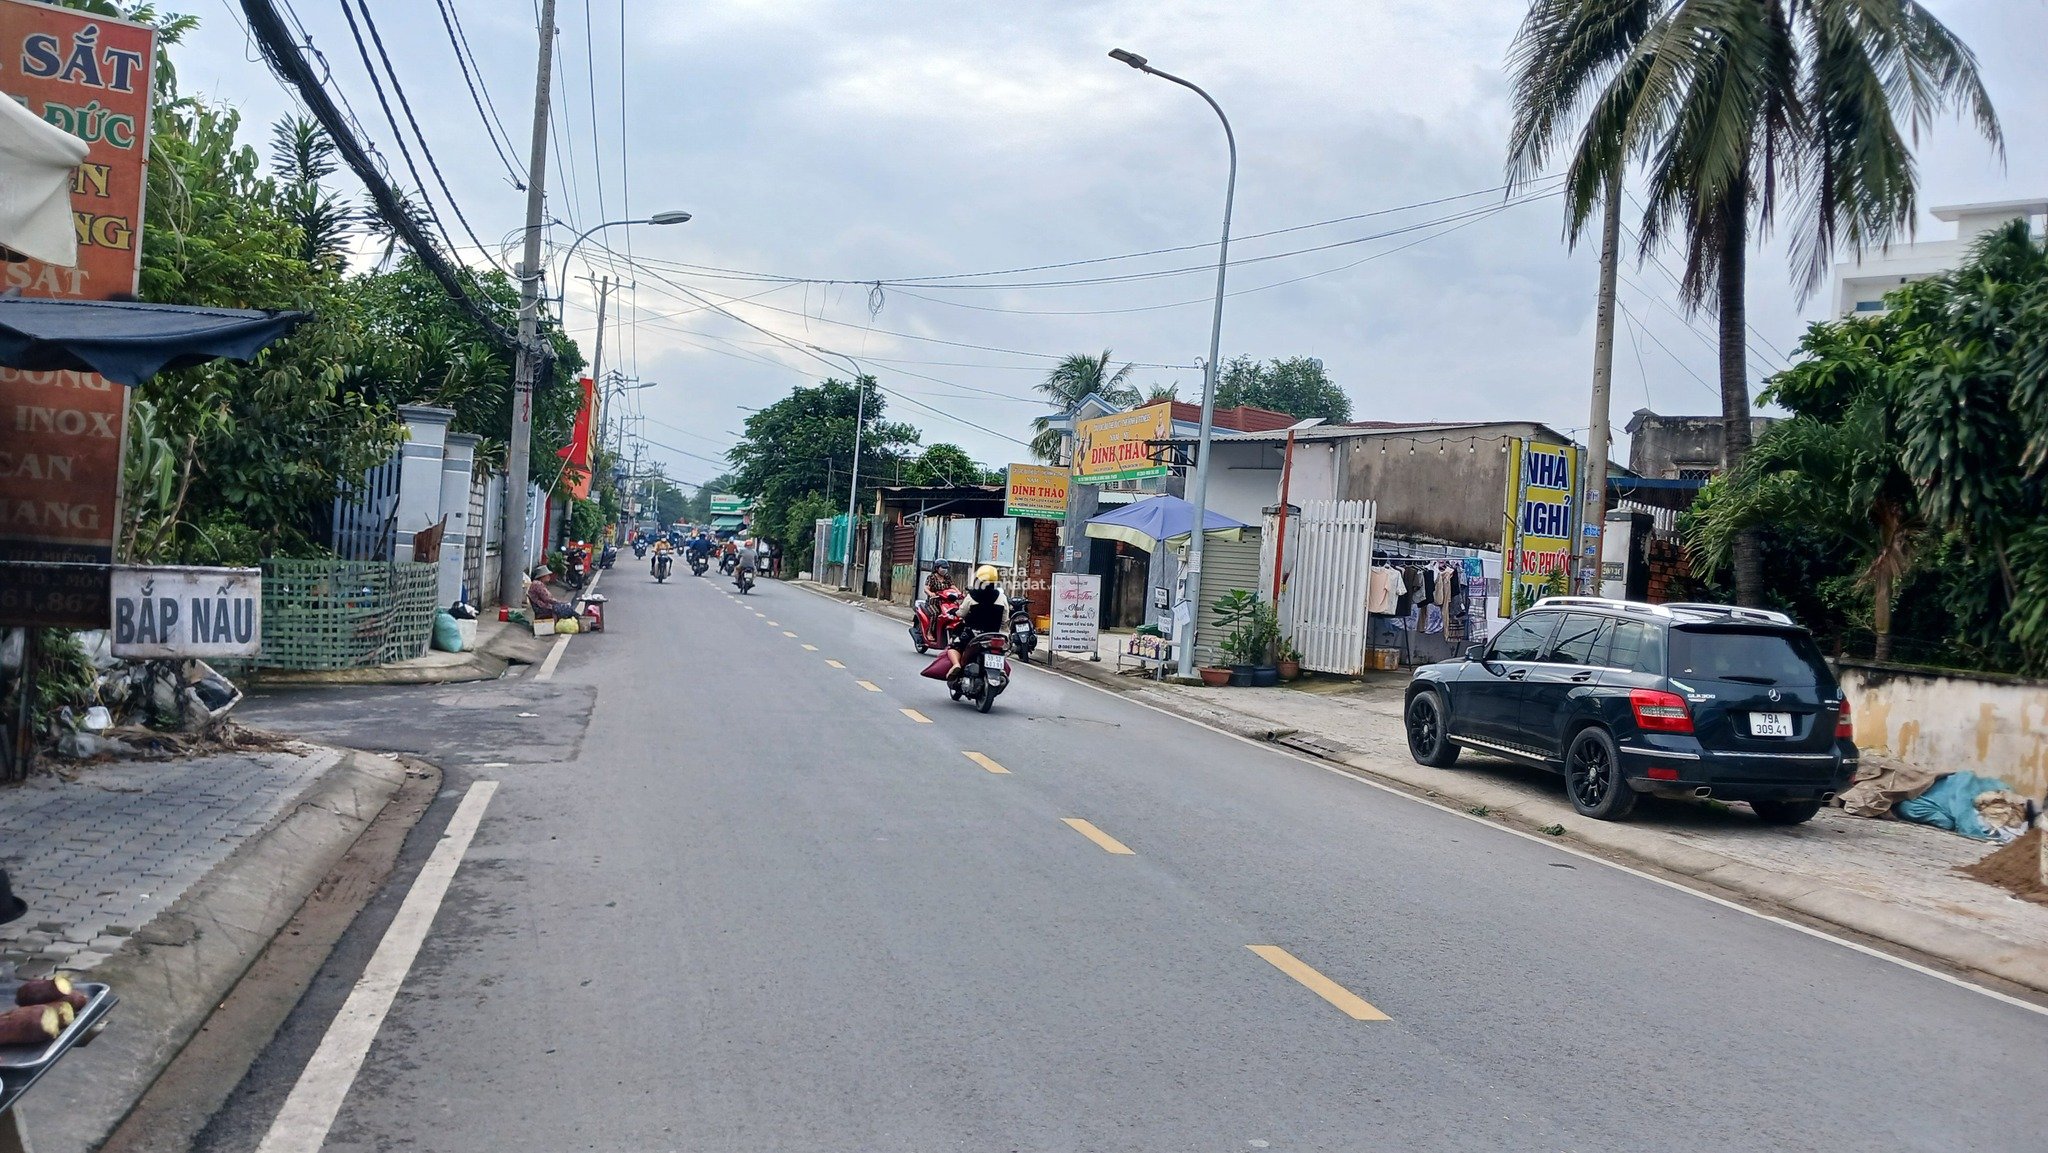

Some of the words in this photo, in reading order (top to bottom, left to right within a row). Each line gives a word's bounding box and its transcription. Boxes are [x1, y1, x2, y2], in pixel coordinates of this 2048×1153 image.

[22, 24, 142, 93] SẮT
[16, 405, 116, 438] INOX
[1527, 451, 1569, 489] NHÀ
[1506, 550, 1536, 575] HNG
[115, 577, 179, 644] BẮP
[191, 580, 253, 644] NẤU
[1757, 724, 1787, 735] 309.41
[1762, 713, 1780, 724] 79A
